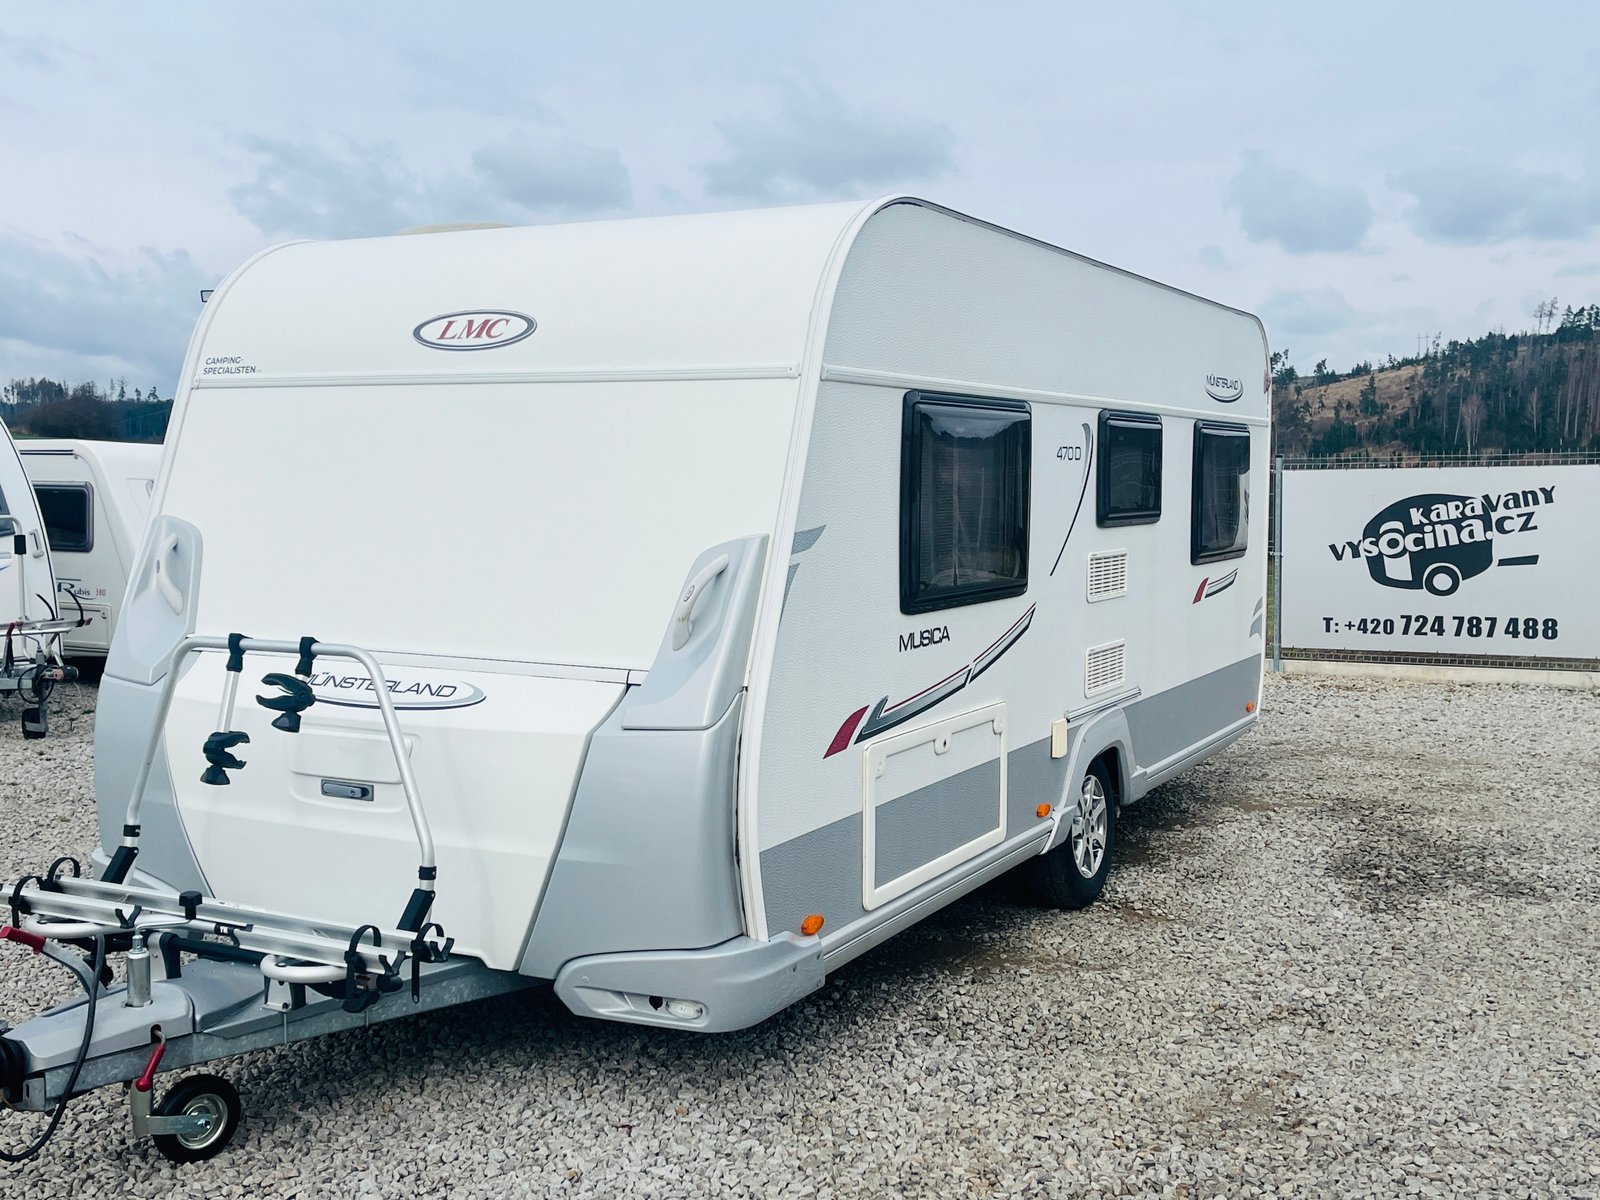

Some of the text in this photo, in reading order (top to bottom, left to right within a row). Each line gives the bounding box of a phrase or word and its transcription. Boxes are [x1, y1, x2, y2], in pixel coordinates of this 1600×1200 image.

[436, 318, 512, 341] LMC
[203, 366, 257, 375] SPECIALISTEN
[56, 581, 91, 598] Rubis
[1322, 614, 1559, 640] T: +420 724 787 488
[899, 625, 951, 653] MUSICA
